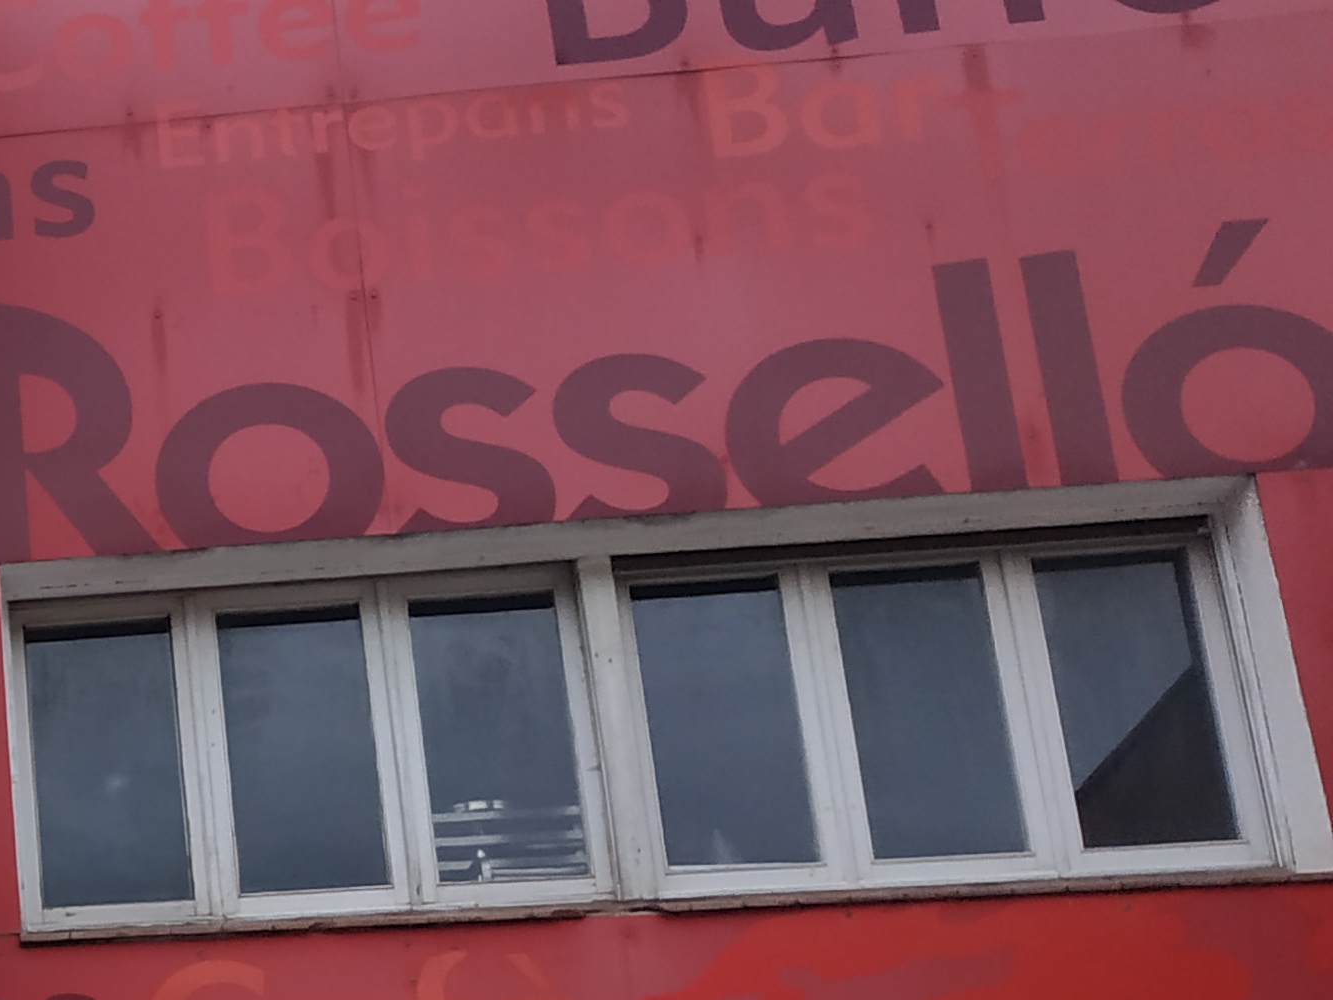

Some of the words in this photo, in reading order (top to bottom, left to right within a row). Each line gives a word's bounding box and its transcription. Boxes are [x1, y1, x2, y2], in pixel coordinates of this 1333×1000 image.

[155, 80, 633, 170] Entrepans
[701, 60, 945, 158] Bar
[201, 172, 875, 300] Boissons
